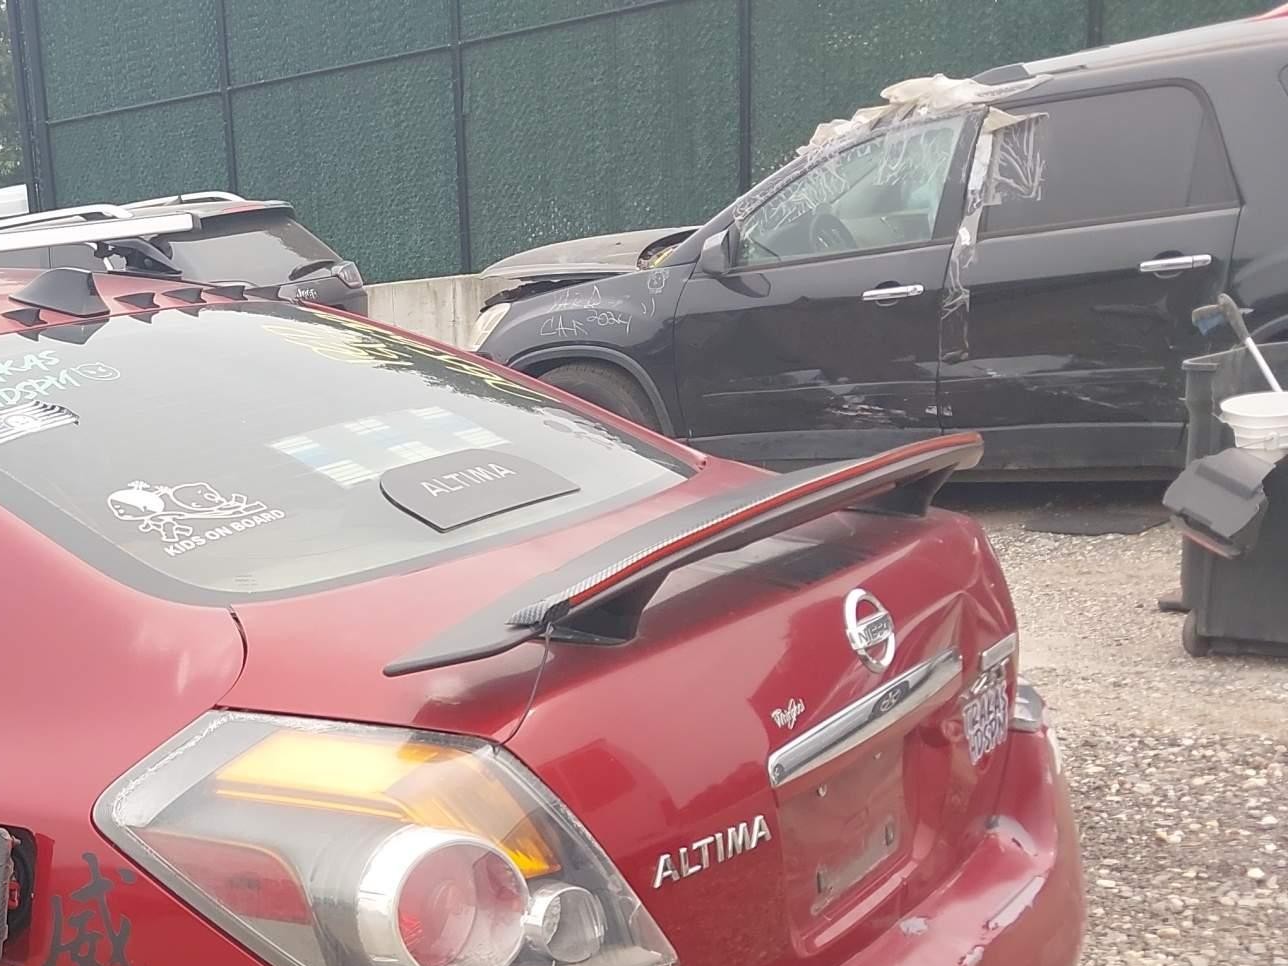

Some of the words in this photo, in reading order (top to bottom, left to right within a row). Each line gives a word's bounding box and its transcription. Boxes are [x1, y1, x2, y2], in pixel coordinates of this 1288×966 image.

[420, 463, 516, 496] ALTIMA
[163, 535, 206, 556] KIDS
[204, 524, 232, 541] ON
[230, 509, 286, 531] BOARD
[652, 814, 772, 889] ALTIMA
